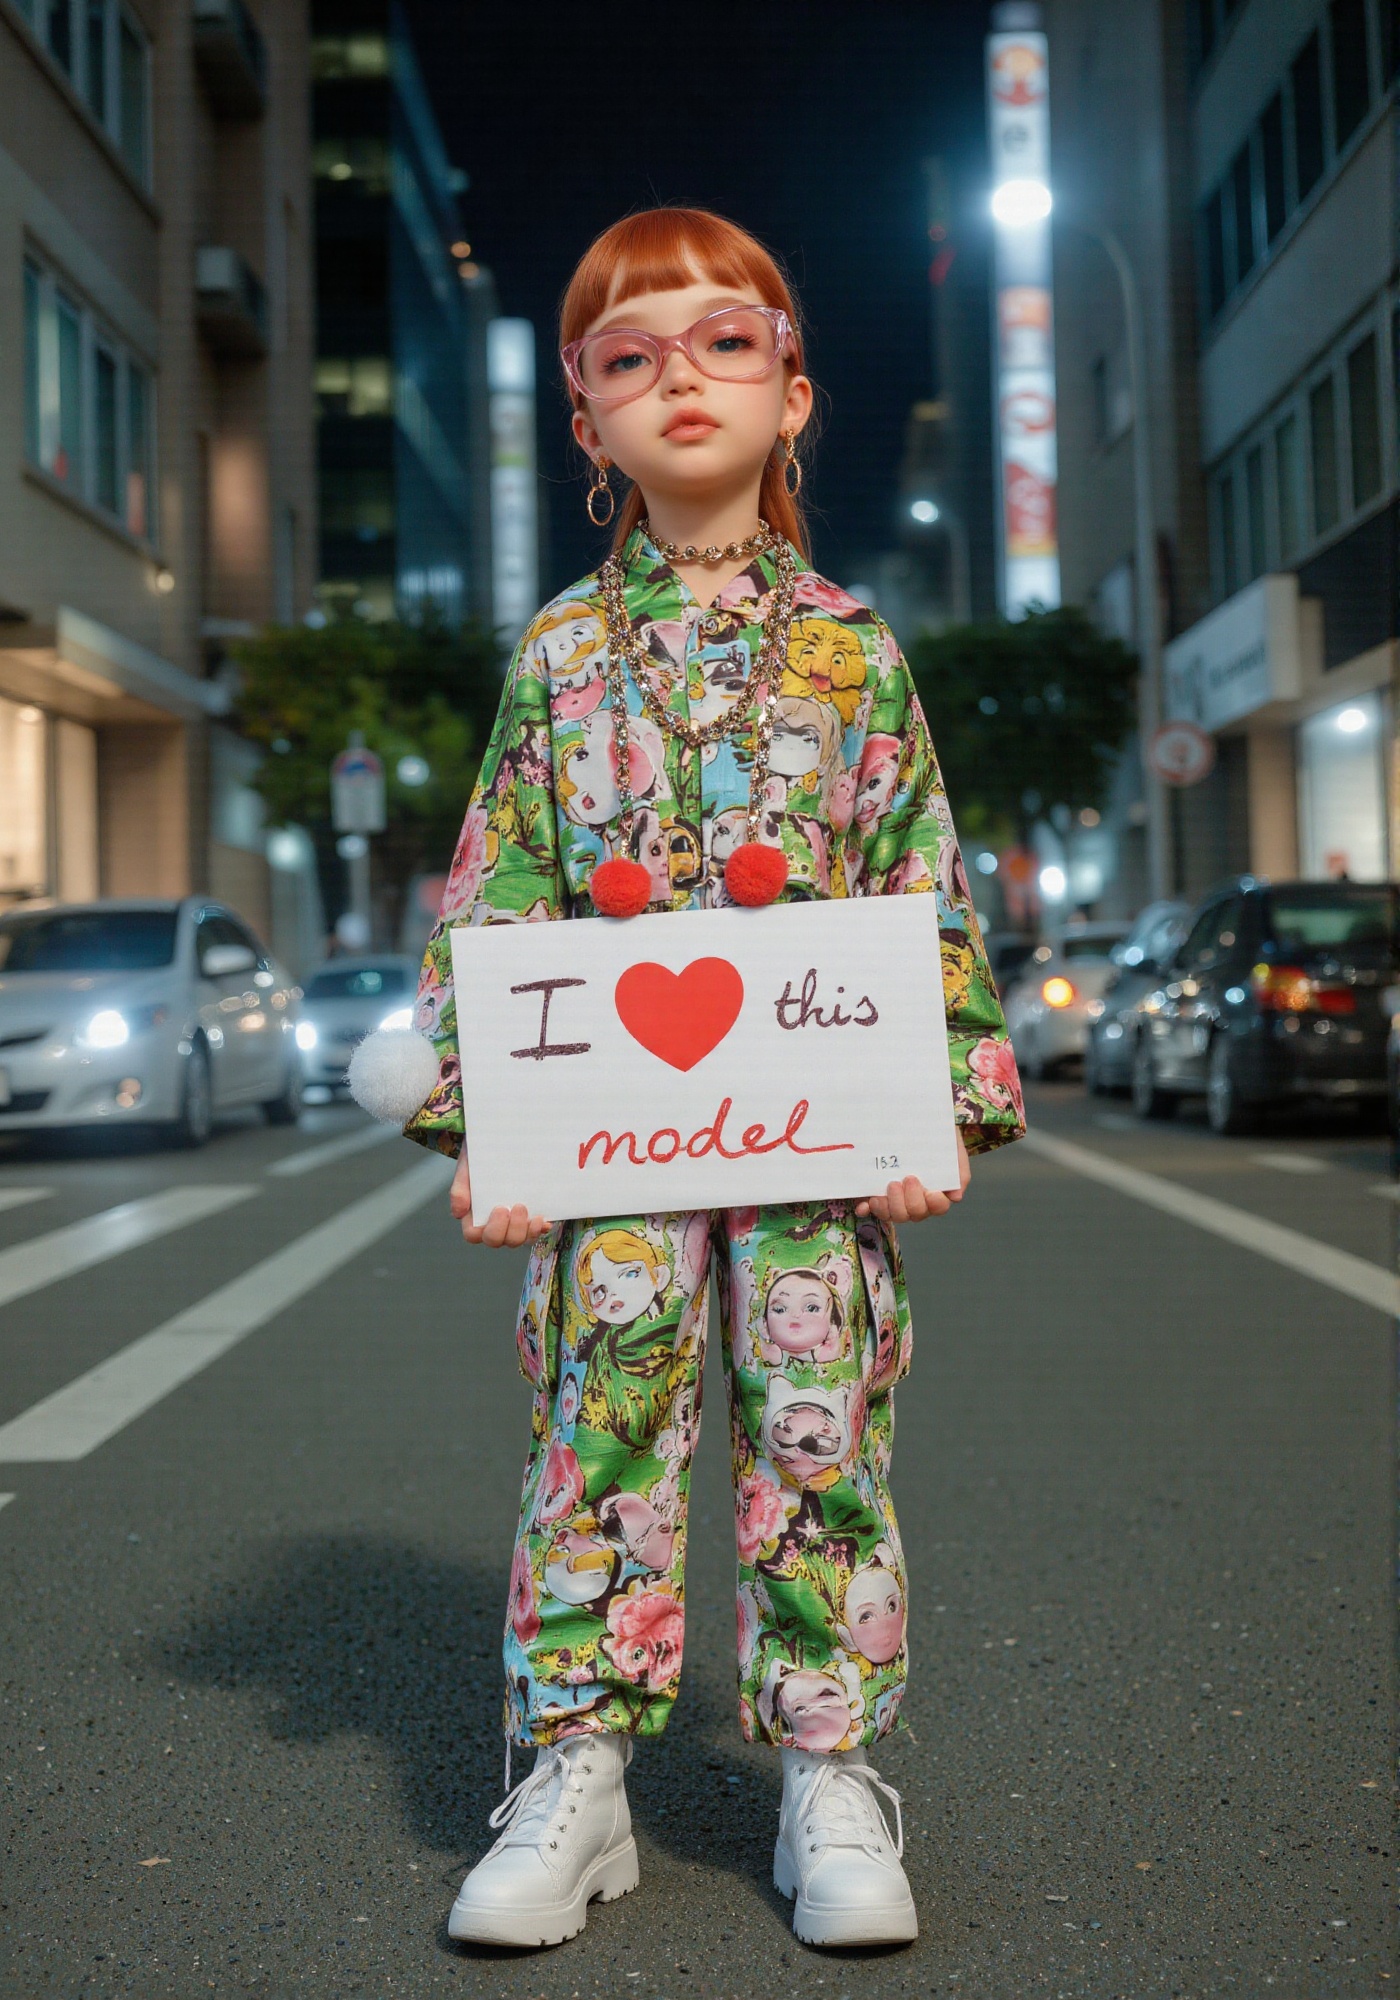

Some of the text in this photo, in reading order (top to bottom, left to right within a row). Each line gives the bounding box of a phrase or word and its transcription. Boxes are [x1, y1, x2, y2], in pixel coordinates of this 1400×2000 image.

[510, 968, 879, 1061] I this
[577, 1096, 855, 1170] model
